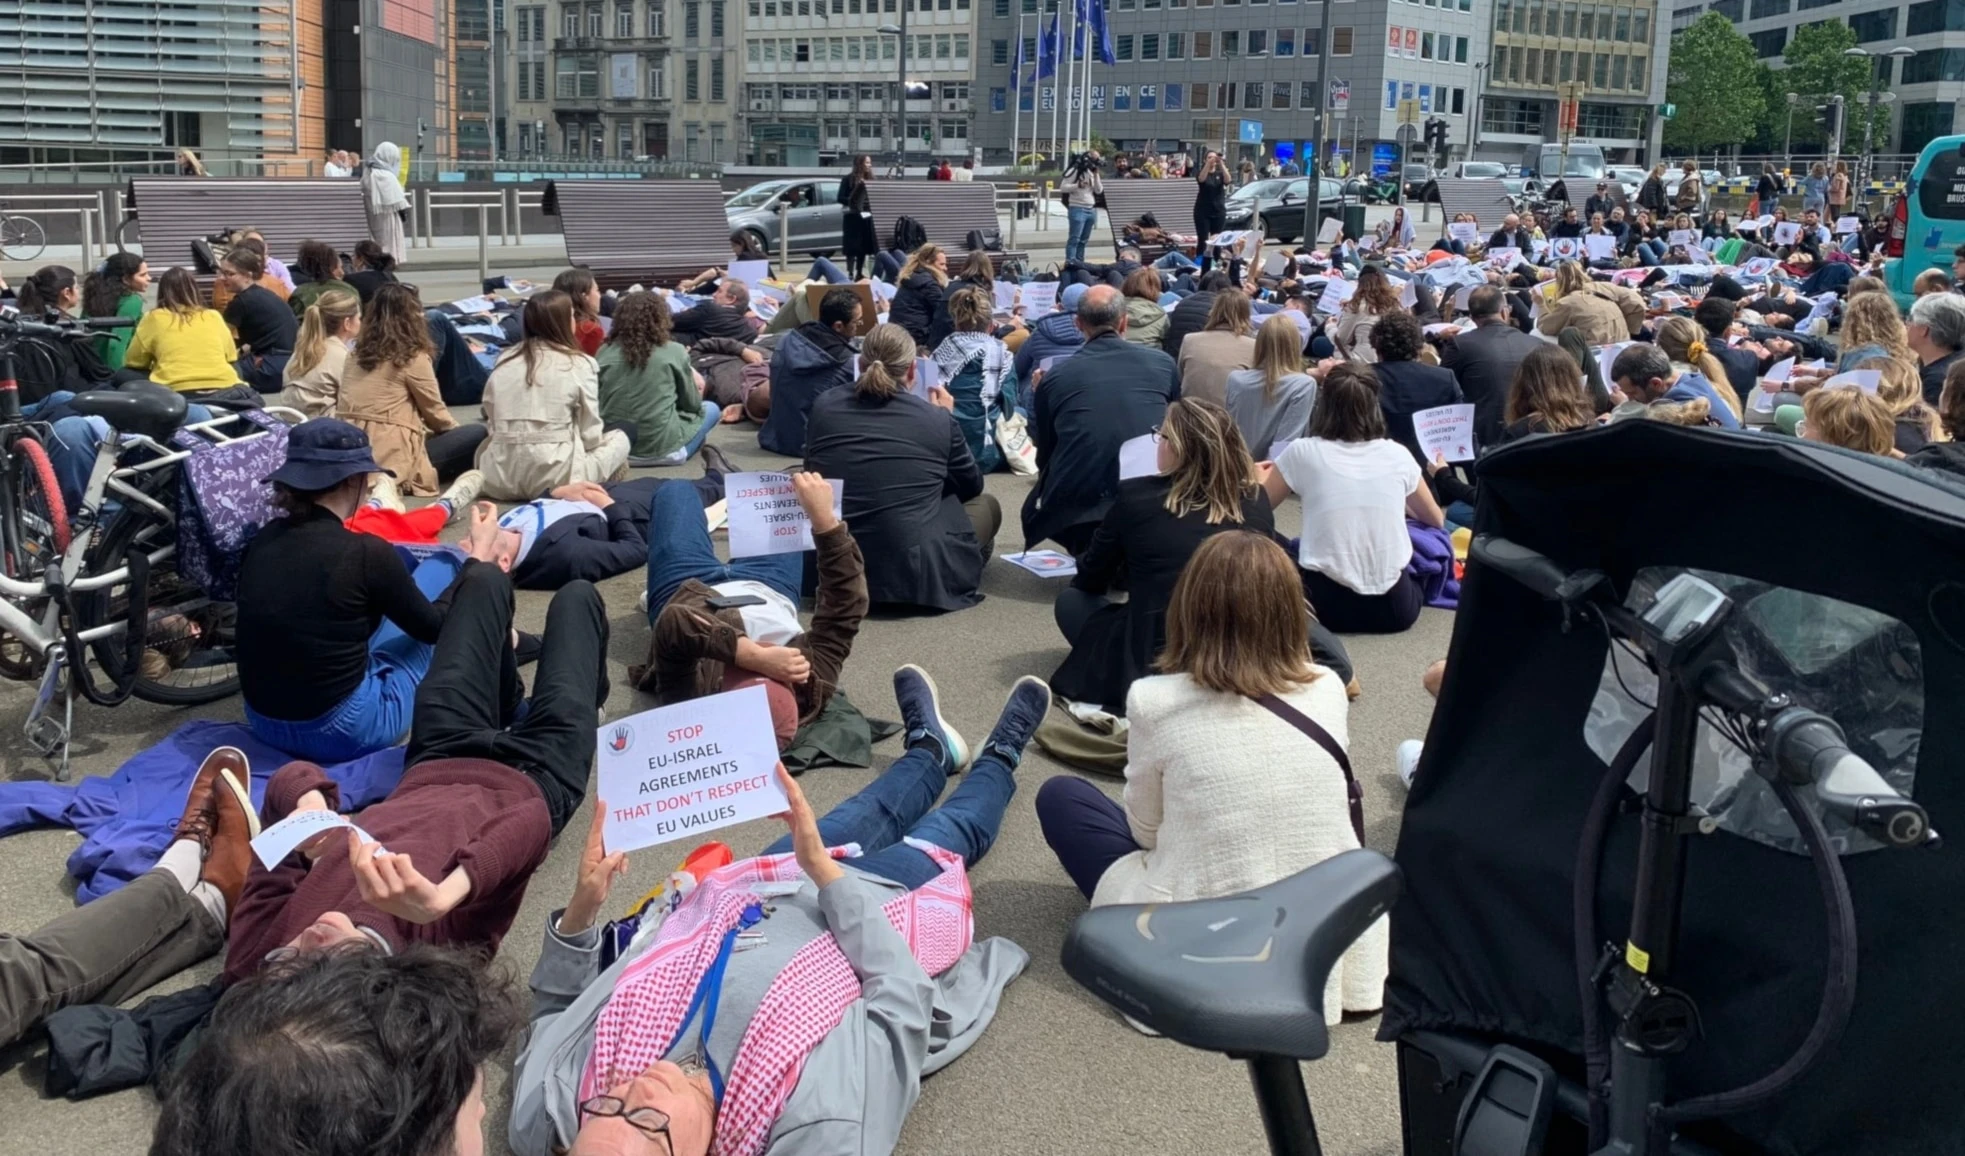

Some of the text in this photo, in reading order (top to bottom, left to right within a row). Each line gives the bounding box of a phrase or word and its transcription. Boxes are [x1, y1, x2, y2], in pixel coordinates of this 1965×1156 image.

[736, 486, 775, 498] RESPECT
[763, 511, 810, 523] EU-ISRAEL
[774, 526, 797, 536] STOP
[667, 724, 704, 743] STOP
[648, 742, 722, 770] EU-ISRAEL
[639, 760, 739, 794] AGREEMENTS
[614, 803, 651, 823] THAT
[708, 775, 768, 800] RESPECT
[656, 805, 736, 835] EU VALUES
